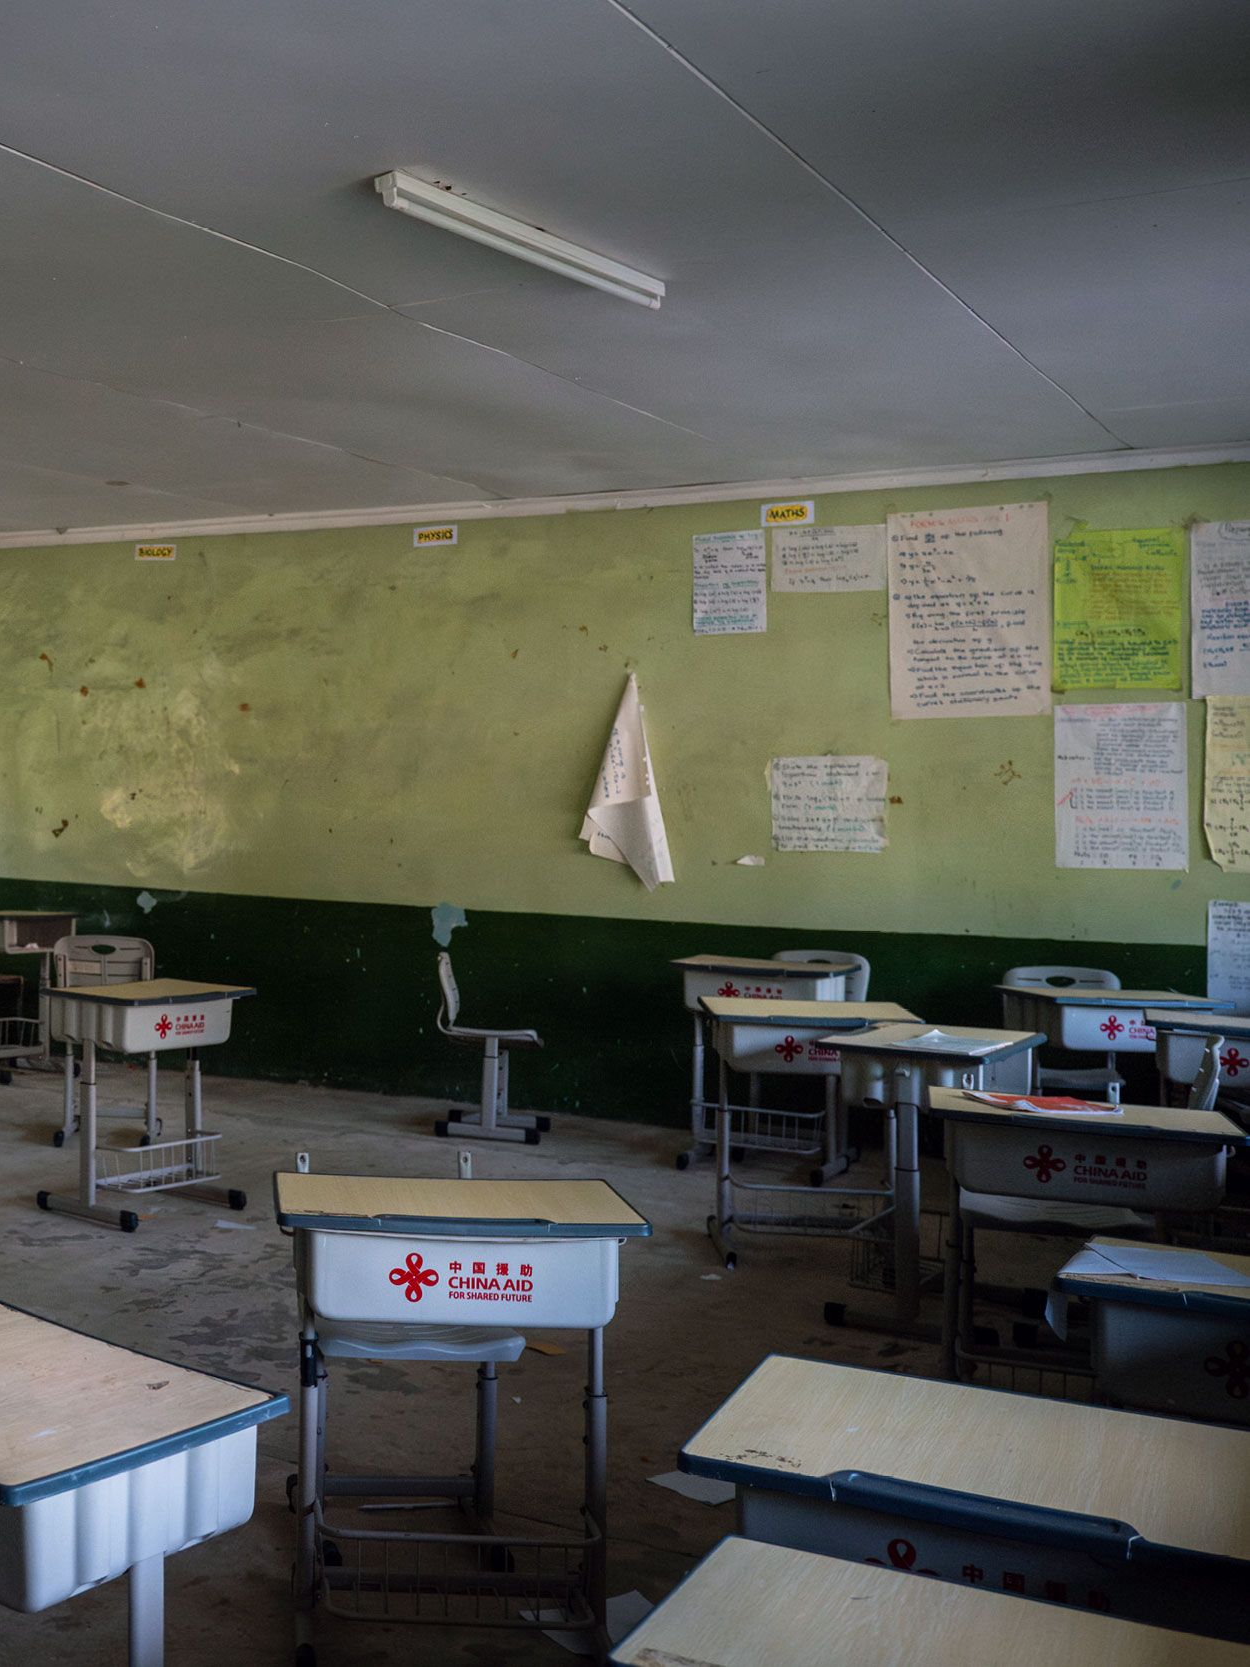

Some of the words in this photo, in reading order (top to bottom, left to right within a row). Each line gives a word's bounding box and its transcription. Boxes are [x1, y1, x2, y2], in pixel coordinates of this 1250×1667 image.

[769, 507, 805, 520] MATHS
[418, 528, 454, 541] PHYSICS
[969, 528, 1004, 537] following
[138, 546, 173, 557] BIOLOGY
[176, 1022, 193, 1030] CHINA
[808, 1048, 838, 1056] CHINA
[1074, 1165, 1118, 1179] CHINA
[1121, 1170, 1148, 1182] AID
[449, 1260, 533, 1278] 中国援助
[448, 1276, 501, 1291] CHINA
[503, 1279, 534, 1292] AID
[448, 1290, 465, 1300] FOR
[466, 1292, 500, 1302] SHARED
[501, 1294, 533, 1303] FUTURE
